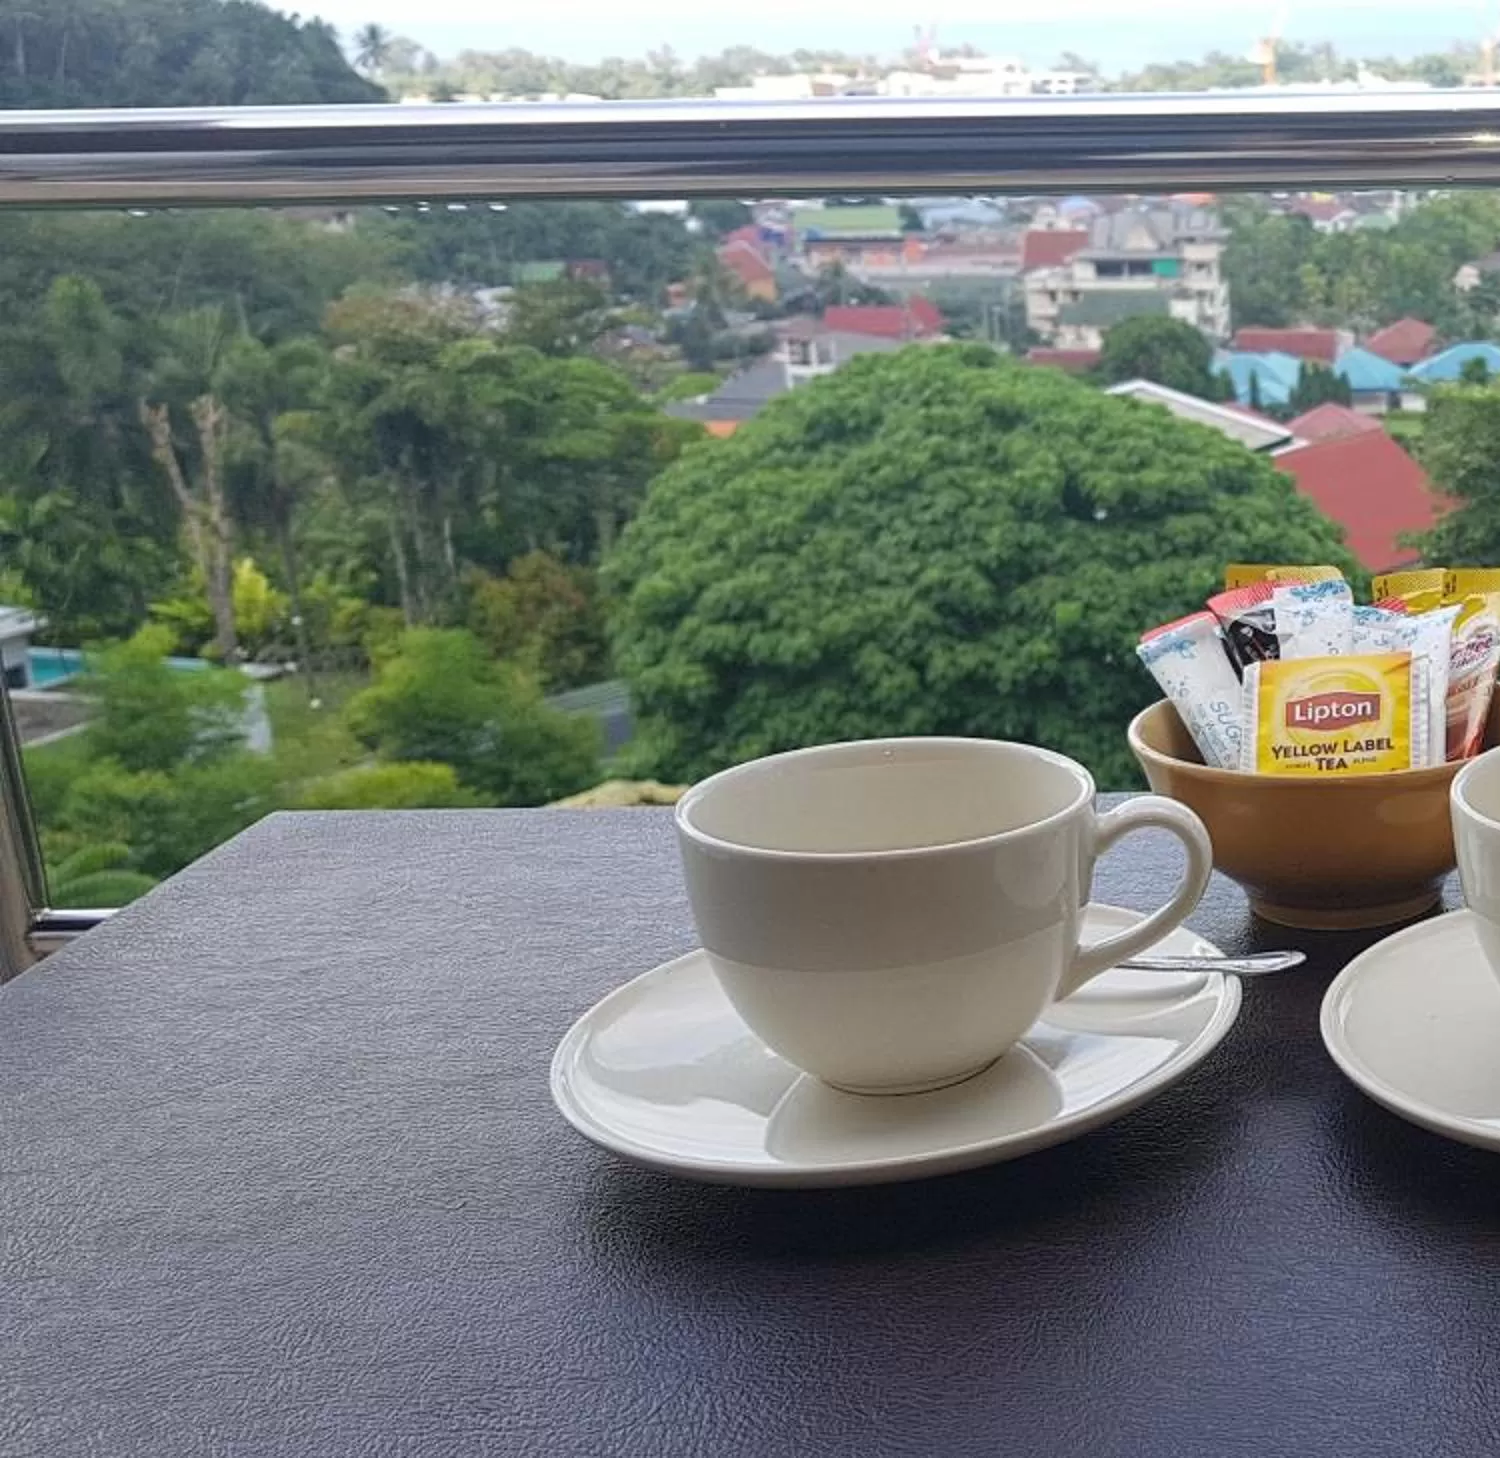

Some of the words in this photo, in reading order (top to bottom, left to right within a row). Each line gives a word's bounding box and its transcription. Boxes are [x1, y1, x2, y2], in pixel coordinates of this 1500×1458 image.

[1294, 701, 1372, 724] Lipton
[1209, 701, 1242, 753] SUG
[1271, 740, 1338, 760] YELLOW
[1343, 737, 1395, 753] LABEL
[1315, 757, 1349, 771] TEA
